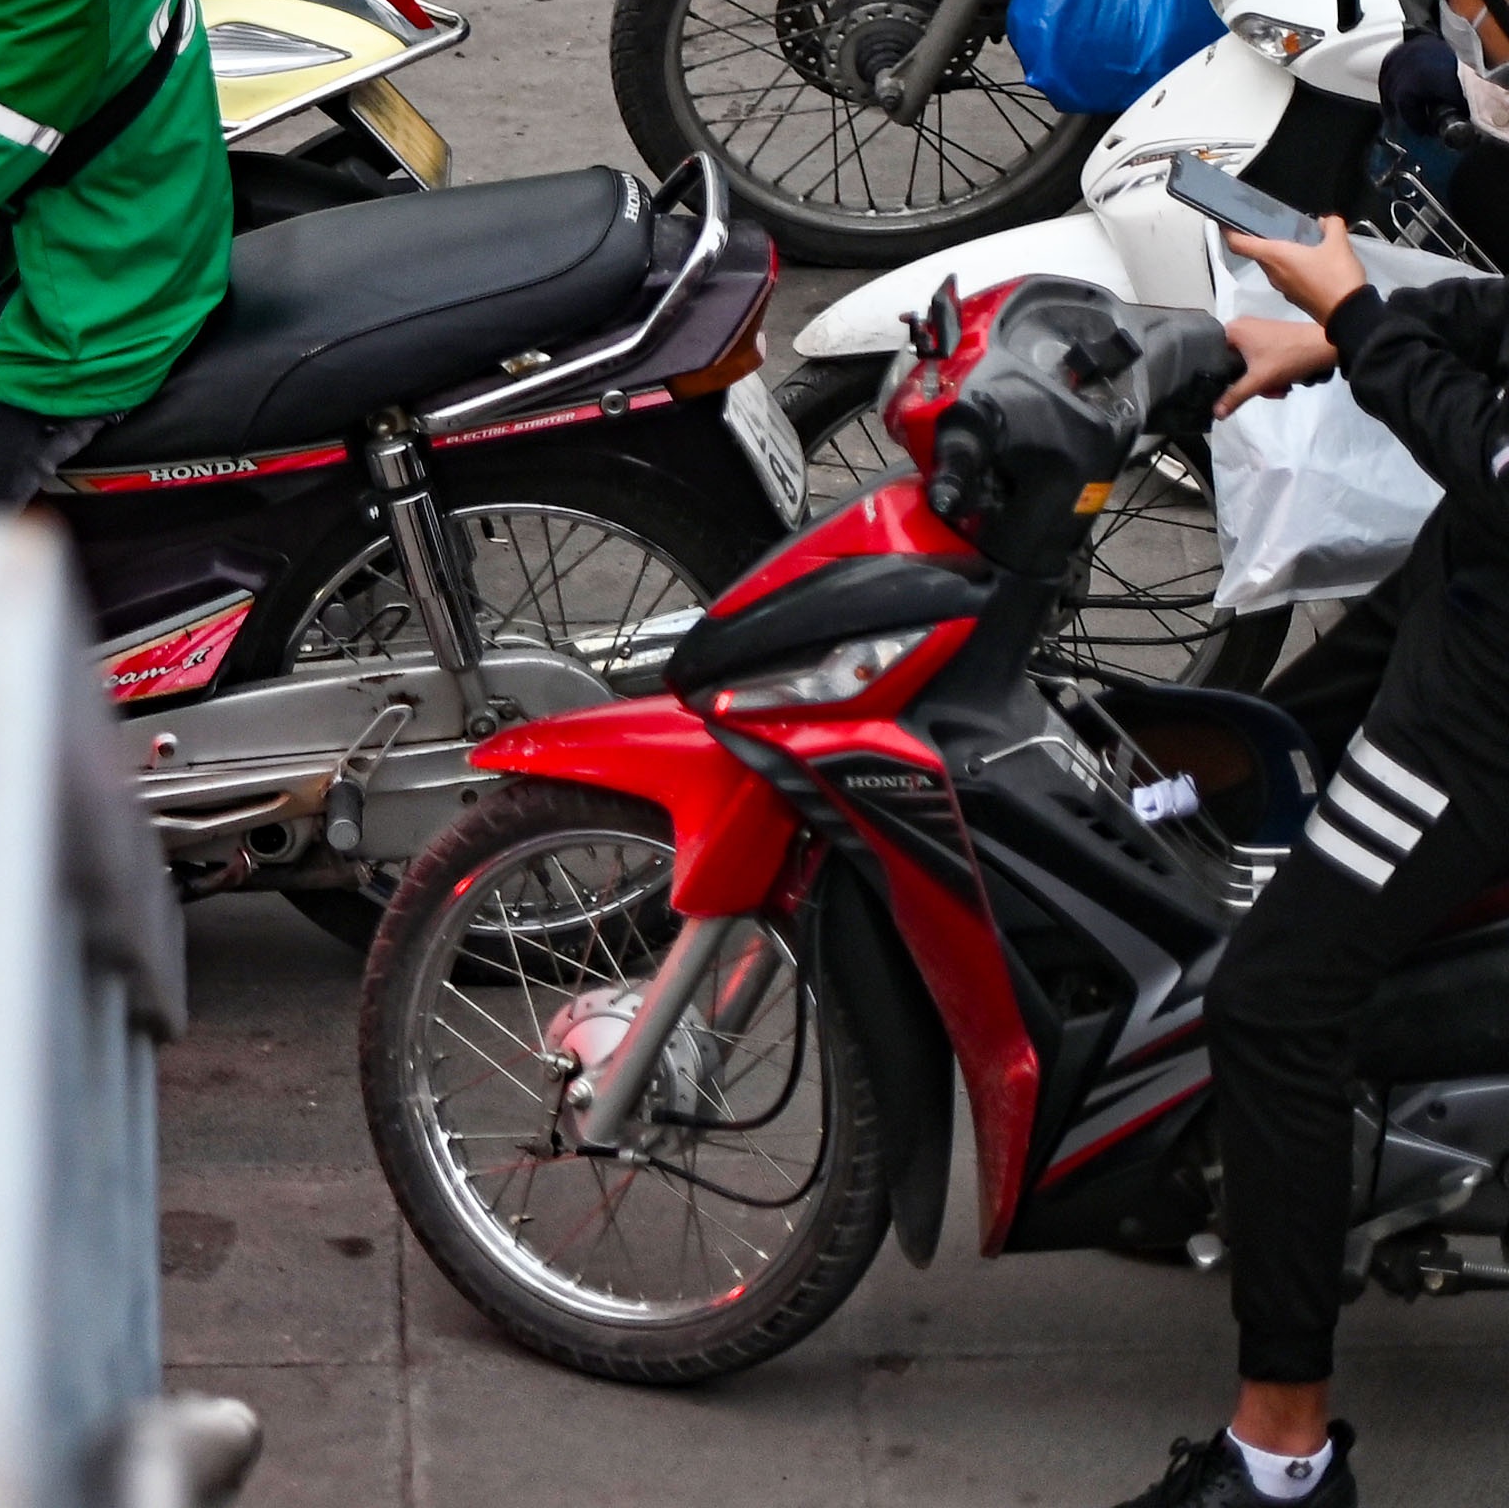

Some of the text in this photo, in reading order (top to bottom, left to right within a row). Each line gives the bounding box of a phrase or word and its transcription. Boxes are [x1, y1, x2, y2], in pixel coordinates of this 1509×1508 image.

[446, 411, 576, 445] ELECTRIC STARTER
[149, 459, 259, 483] HONDA
[105, 664, 180, 688] eam
[846, 775, 935, 790] HONDA
